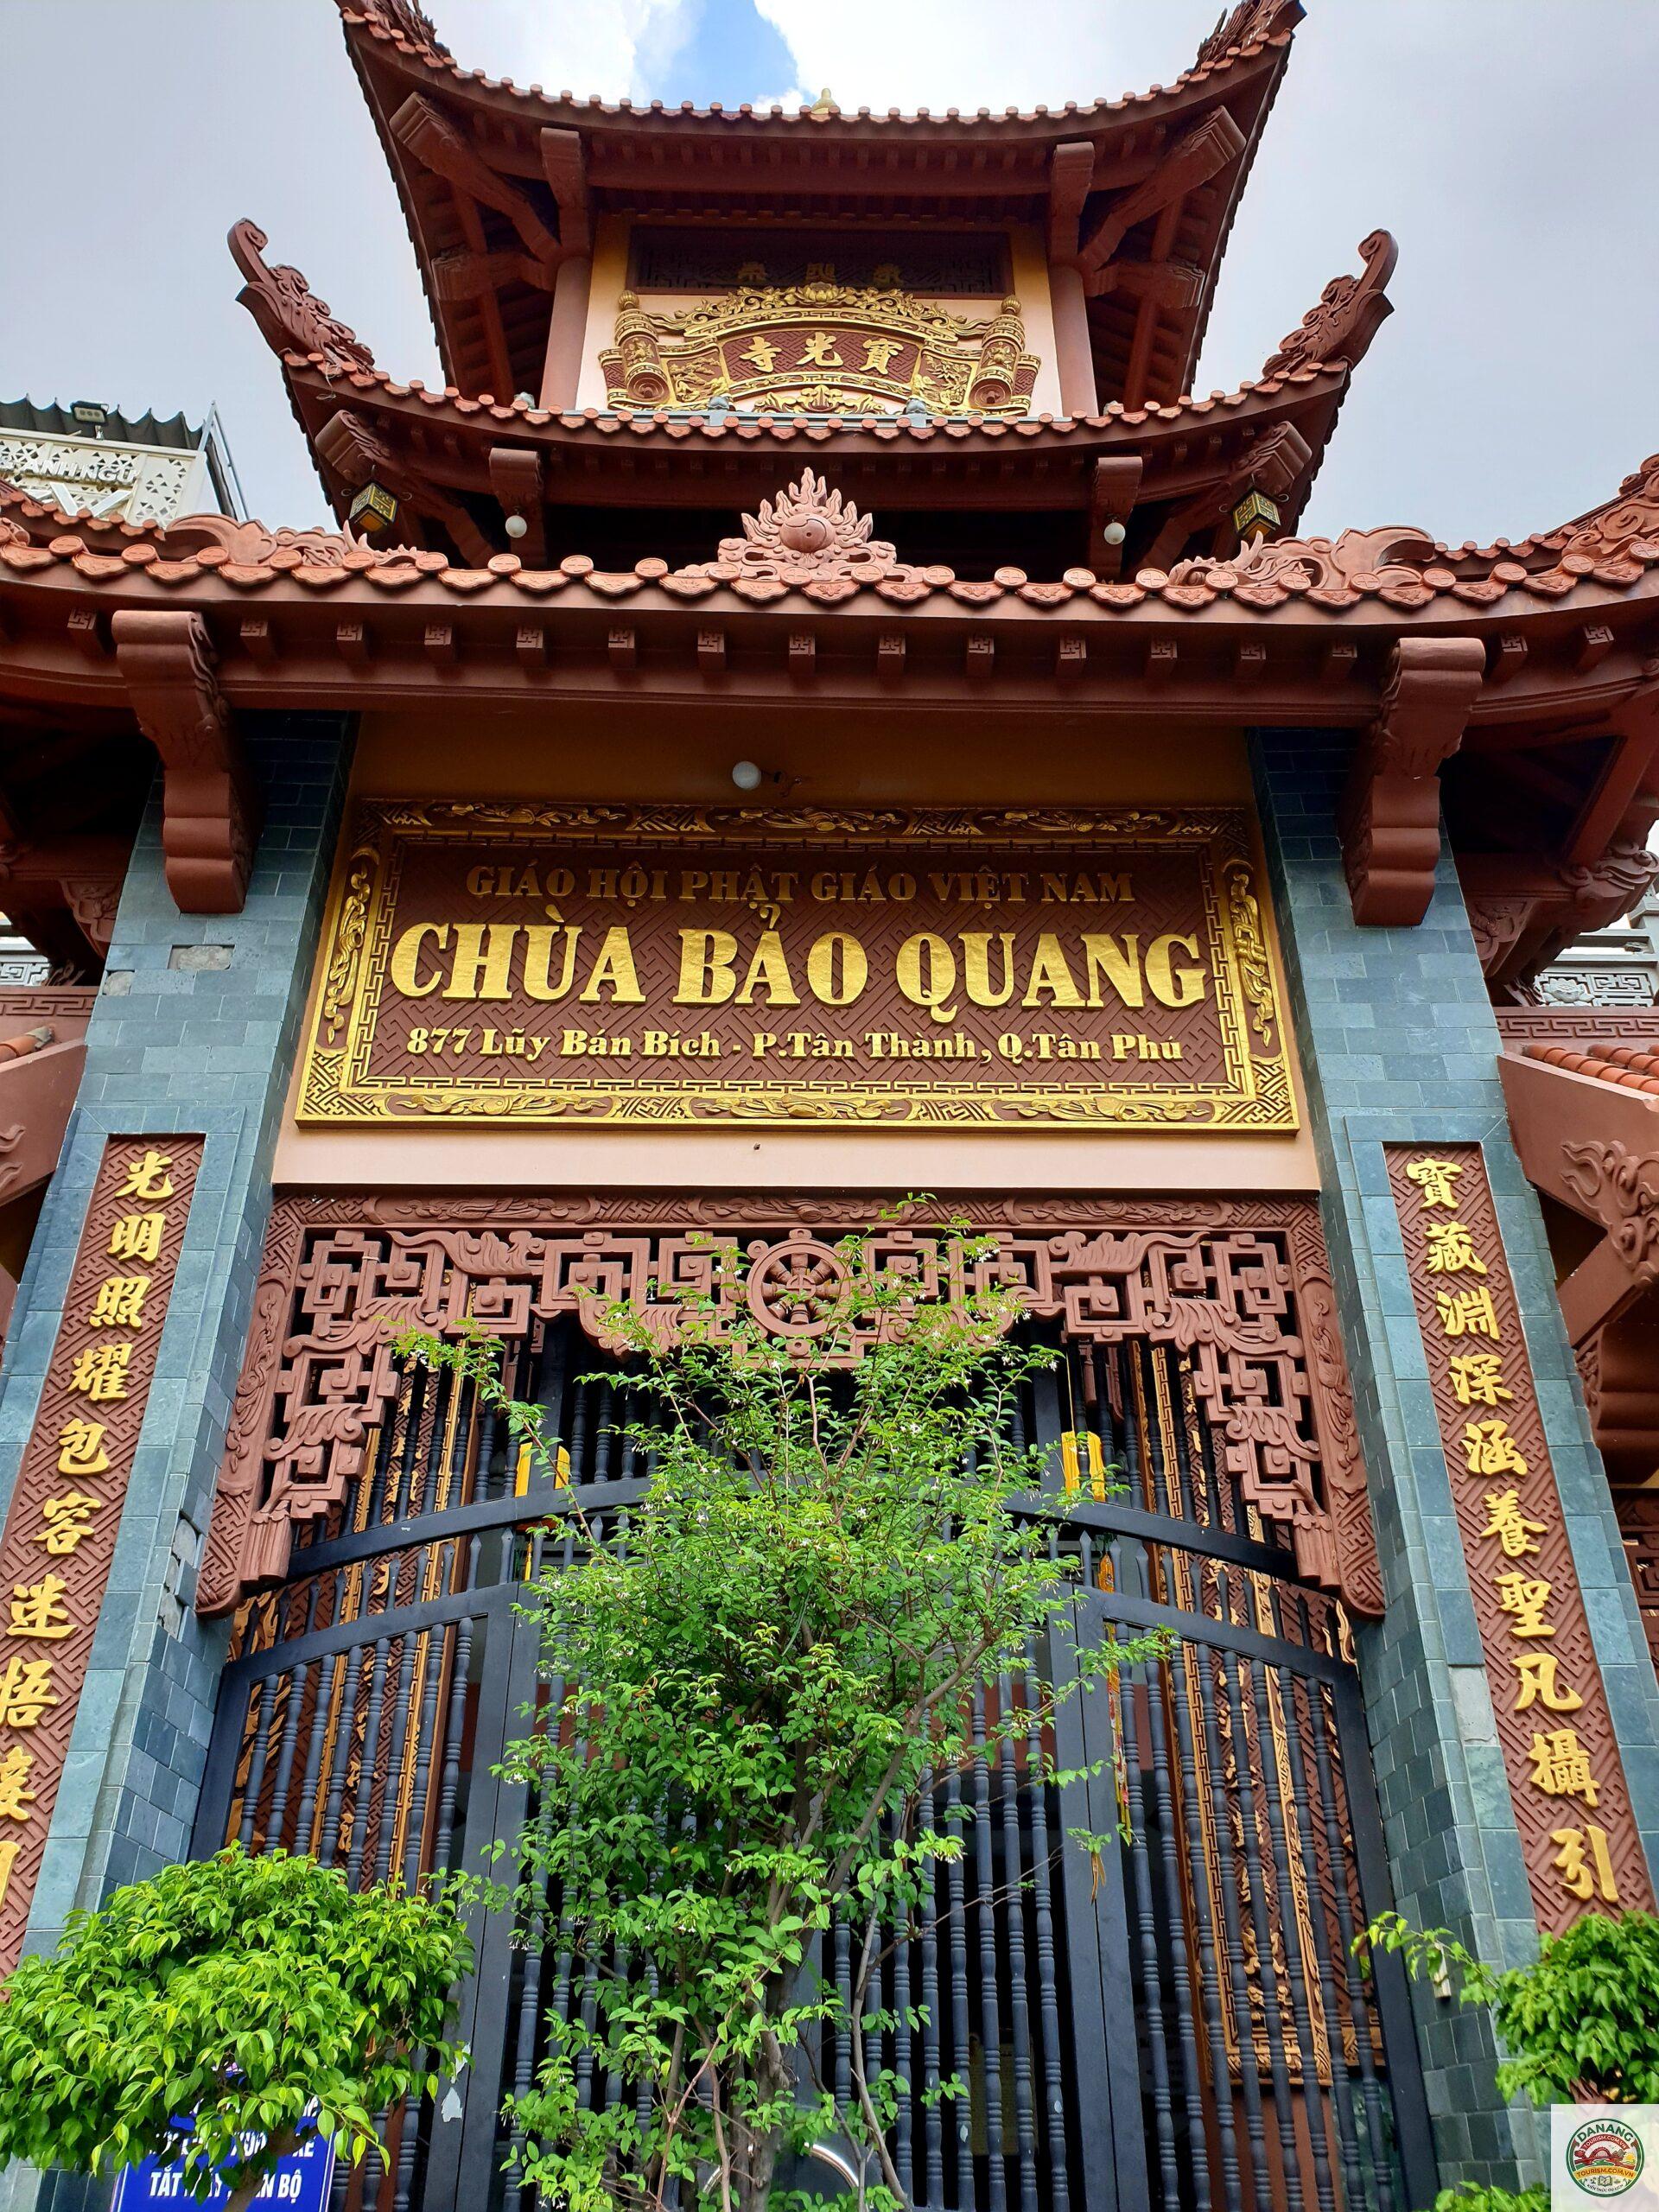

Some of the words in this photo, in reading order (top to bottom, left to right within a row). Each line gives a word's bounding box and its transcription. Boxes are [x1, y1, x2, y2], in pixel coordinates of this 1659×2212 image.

[21, 459, 79, 478] ANH
[467, 860, 575, 898] GIÁO
[588, 861, 669, 907] HỘI
[680, 864, 799, 910] PHẬT
[810, 865, 917, 901] GIÁO
[928, 867, 1029, 910] VIỆT
[1040, 872, 1135, 902] NAM
[391, 904, 646, 1004] CHÙA
[673, 903, 868, 1006] BẢO
[896, 931, 1206, 1024] QUANG
[406, 1027, 473, 1055] 877
[480, 1027, 551, 1062] Lũy
[561, 1029, 632, 1057] Bán
[643, 1029, 721, 1058] Bích
[753, 1031, 854, 1061] P.Tân
[864, 1031, 992, 1064] Thành,
[998, 1032, 1101, 1065] Q.Tân
[1109, 1033, 1183, 1062] Phú
[149, 2163, 183, 2196] TẮT
[277, 2169, 302, 2204] BỘ
